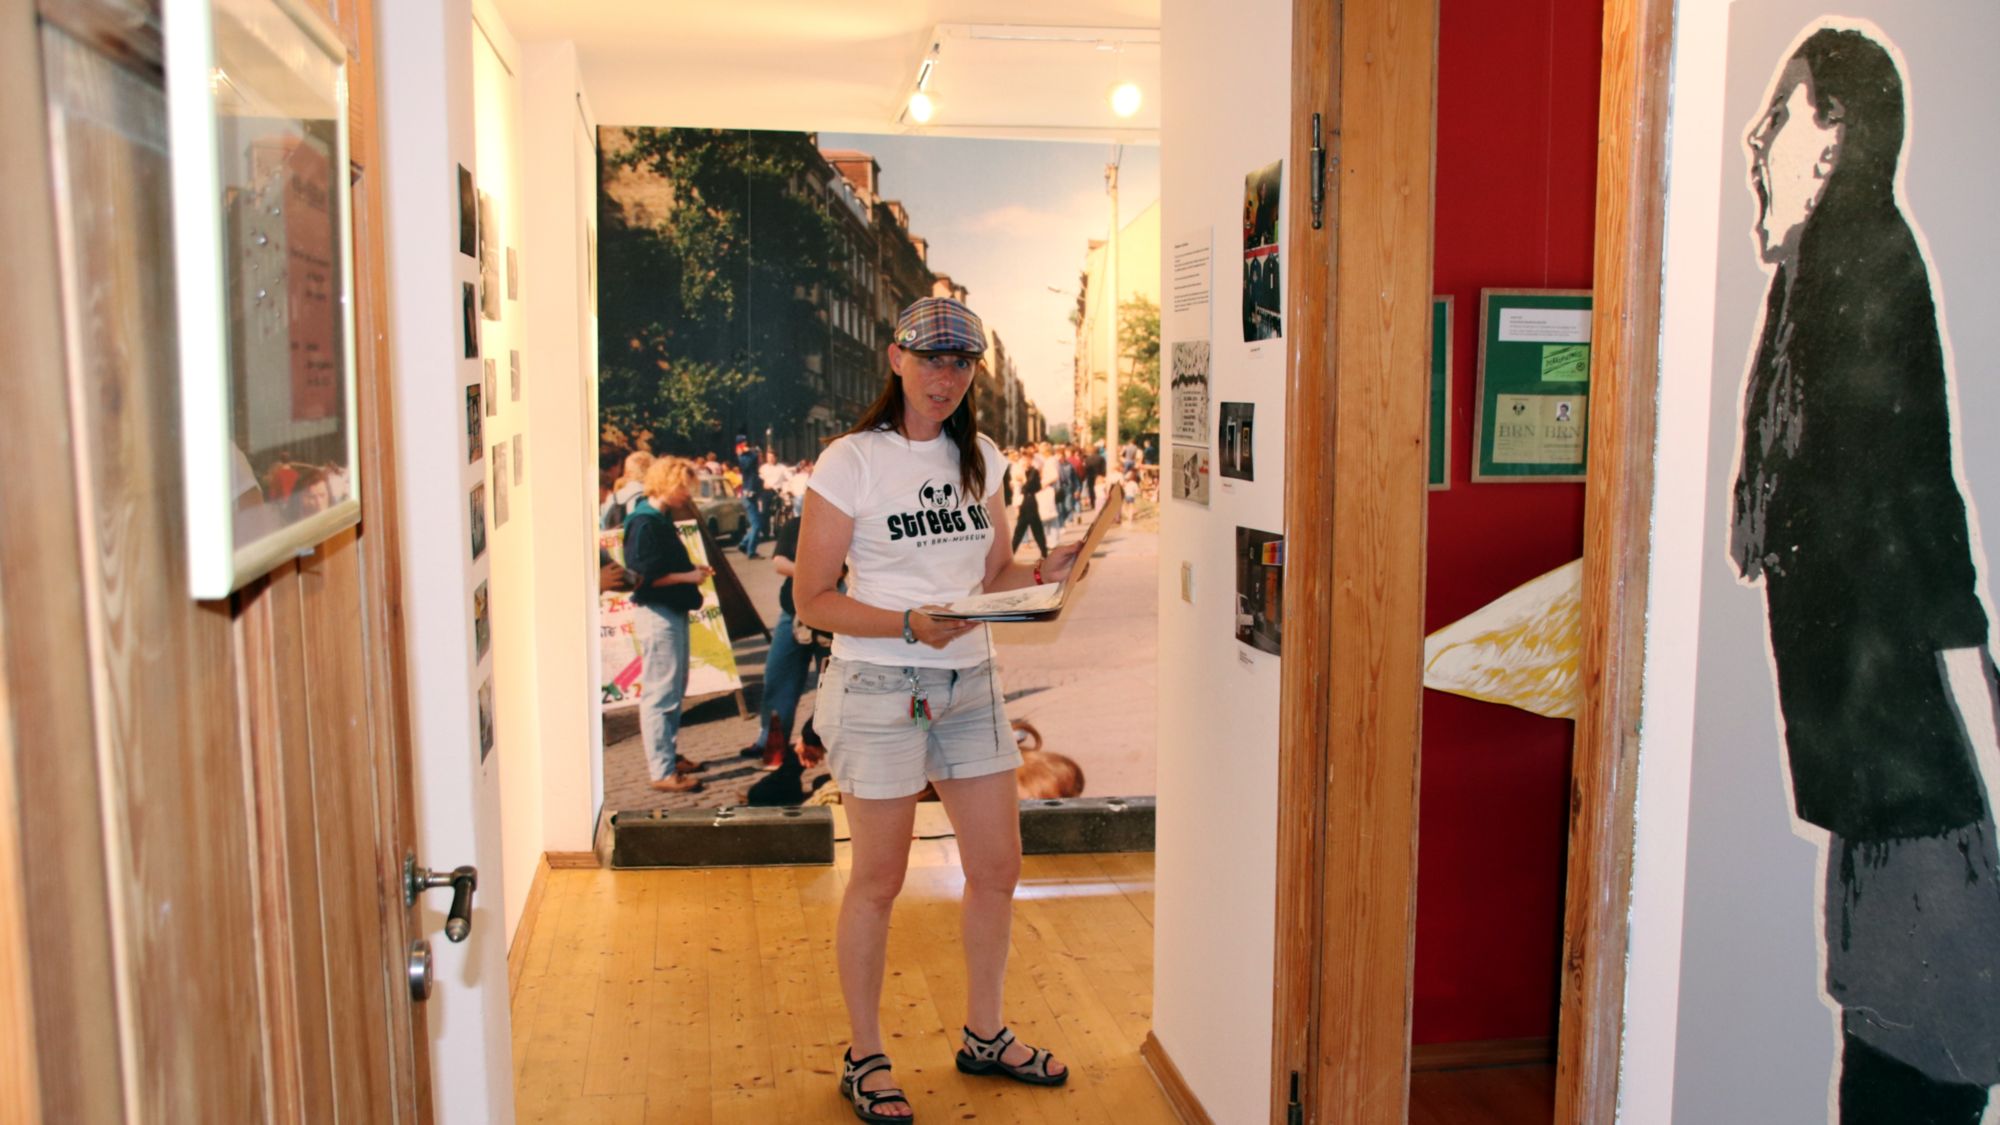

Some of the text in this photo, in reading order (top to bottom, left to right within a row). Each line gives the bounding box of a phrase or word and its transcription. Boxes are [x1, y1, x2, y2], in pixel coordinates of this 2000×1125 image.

[1499, 423, 1581, 438] BRN BRN
[931, 533, 986, 545] BRN-MUSEUM
